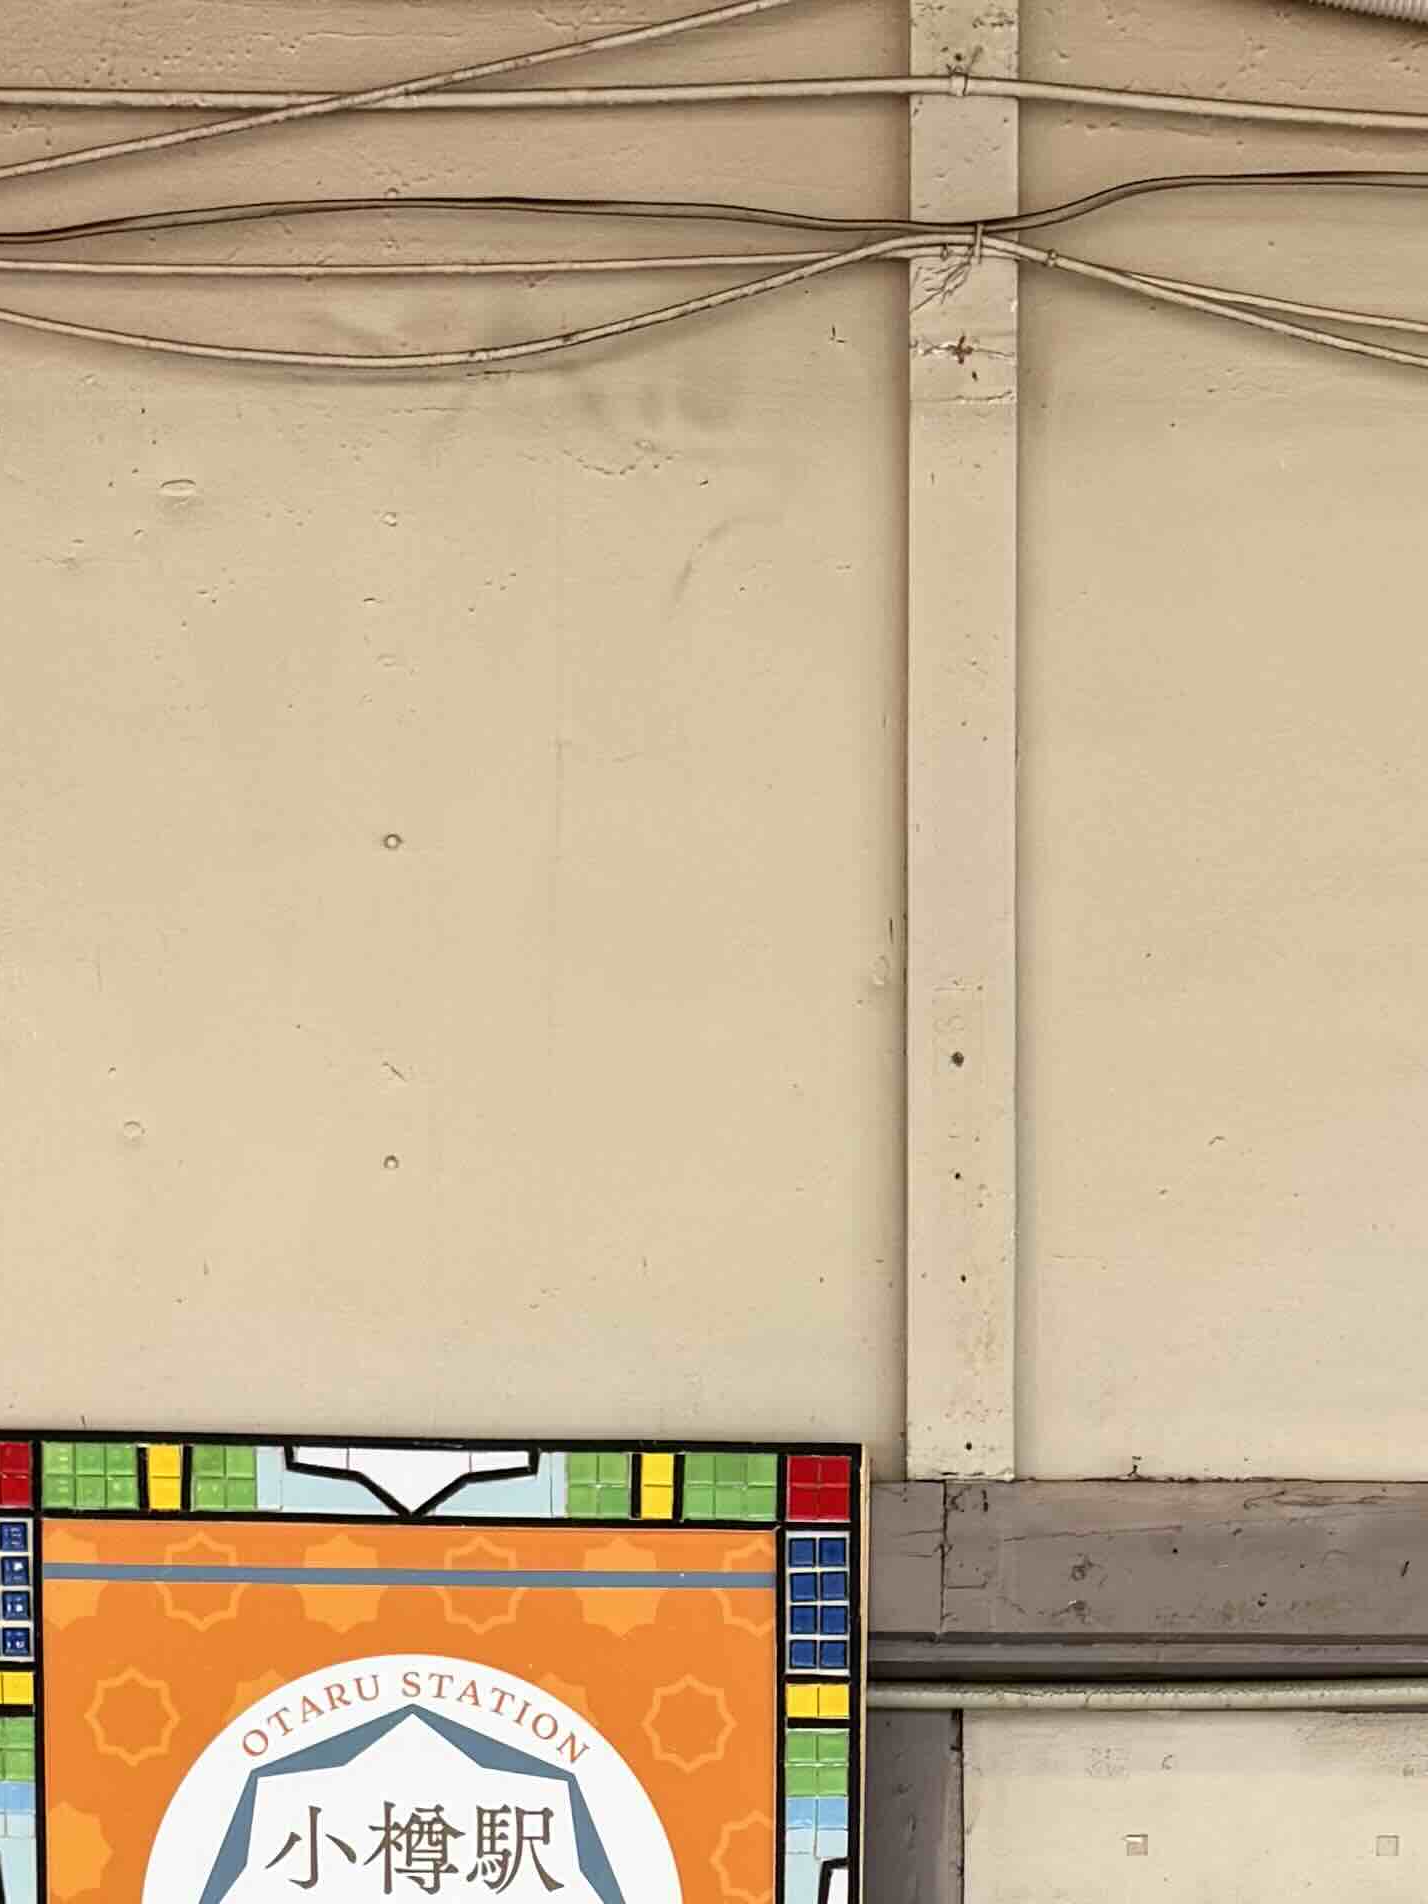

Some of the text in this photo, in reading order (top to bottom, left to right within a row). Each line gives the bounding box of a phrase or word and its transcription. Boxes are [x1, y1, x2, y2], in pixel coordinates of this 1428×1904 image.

[242, 1671, 590, 1763] OTARU STATION
[264, 1800, 565, 1895] 小樽駅
